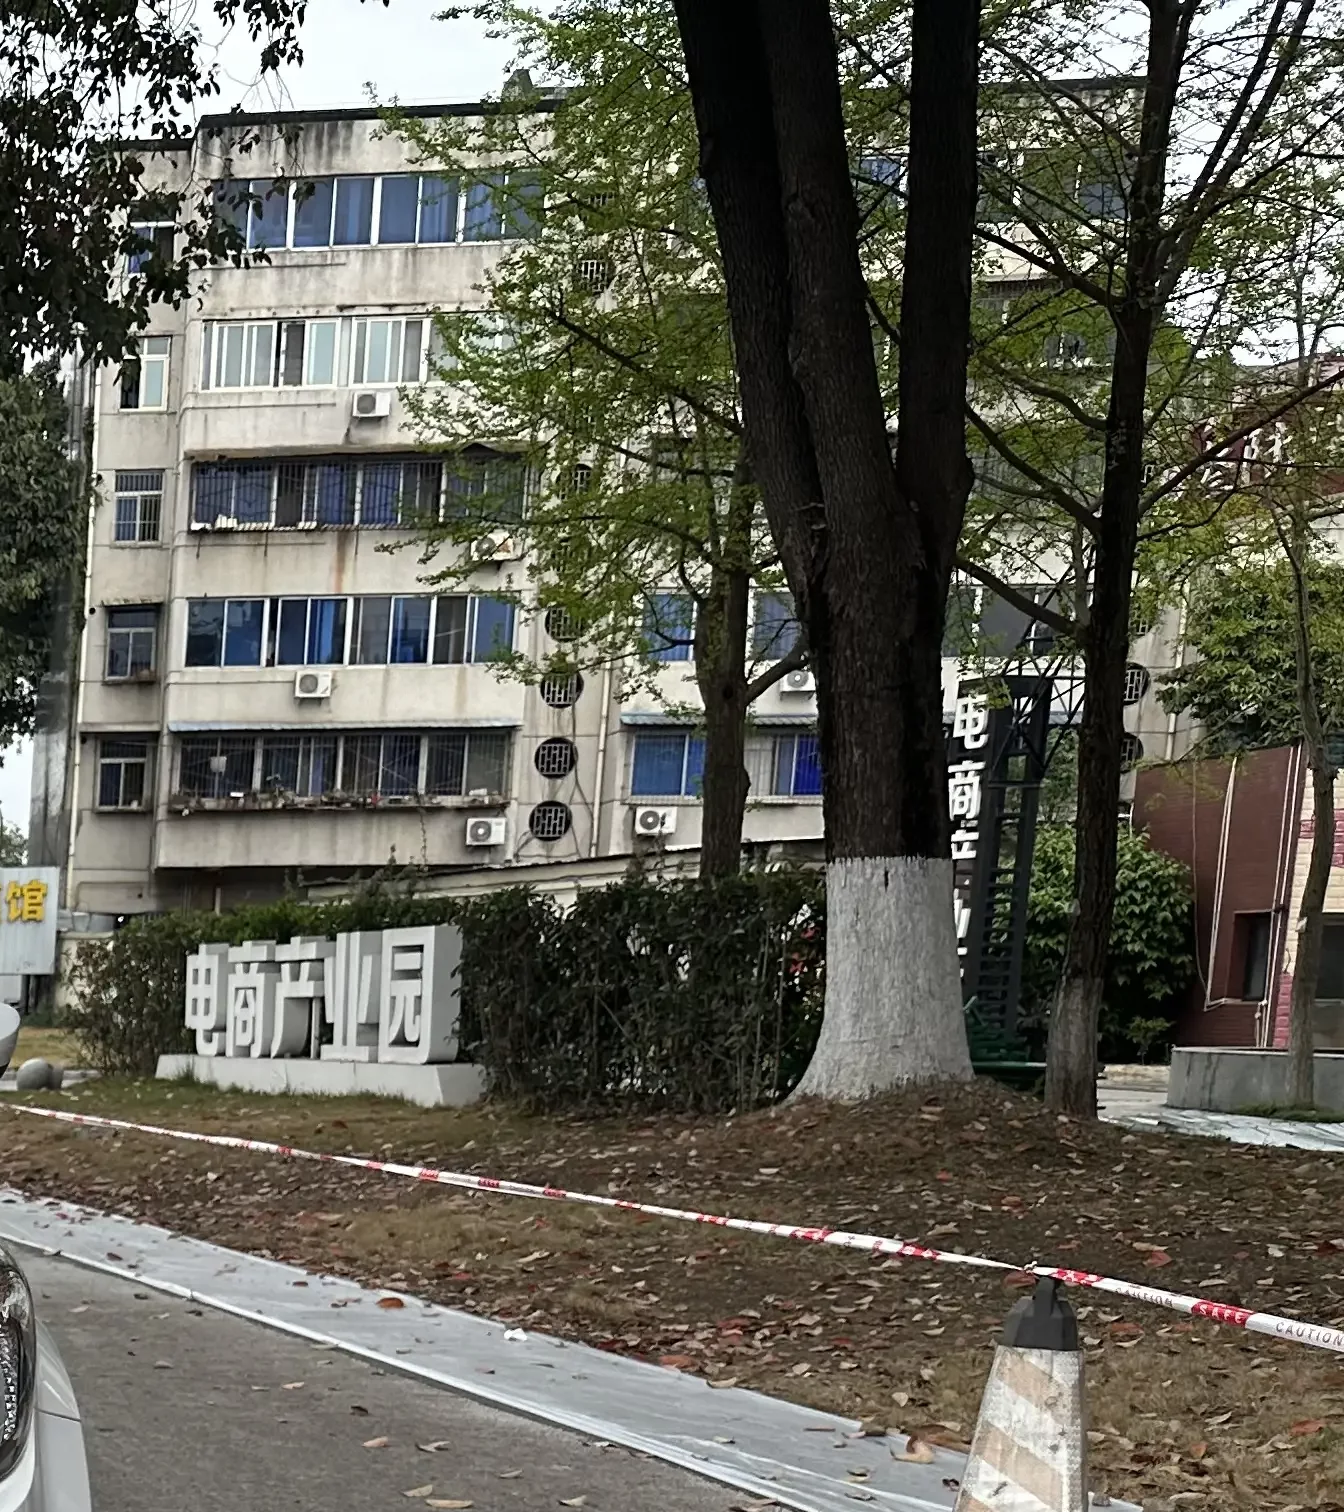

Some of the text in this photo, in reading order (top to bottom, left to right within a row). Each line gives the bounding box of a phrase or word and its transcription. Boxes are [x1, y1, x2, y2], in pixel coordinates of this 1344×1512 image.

[185, 925, 447, 1065] 电商产业园
[1199, 1301, 1245, 1323] SAFE
[1275, 1321, 1344, 1347] CAUTION
